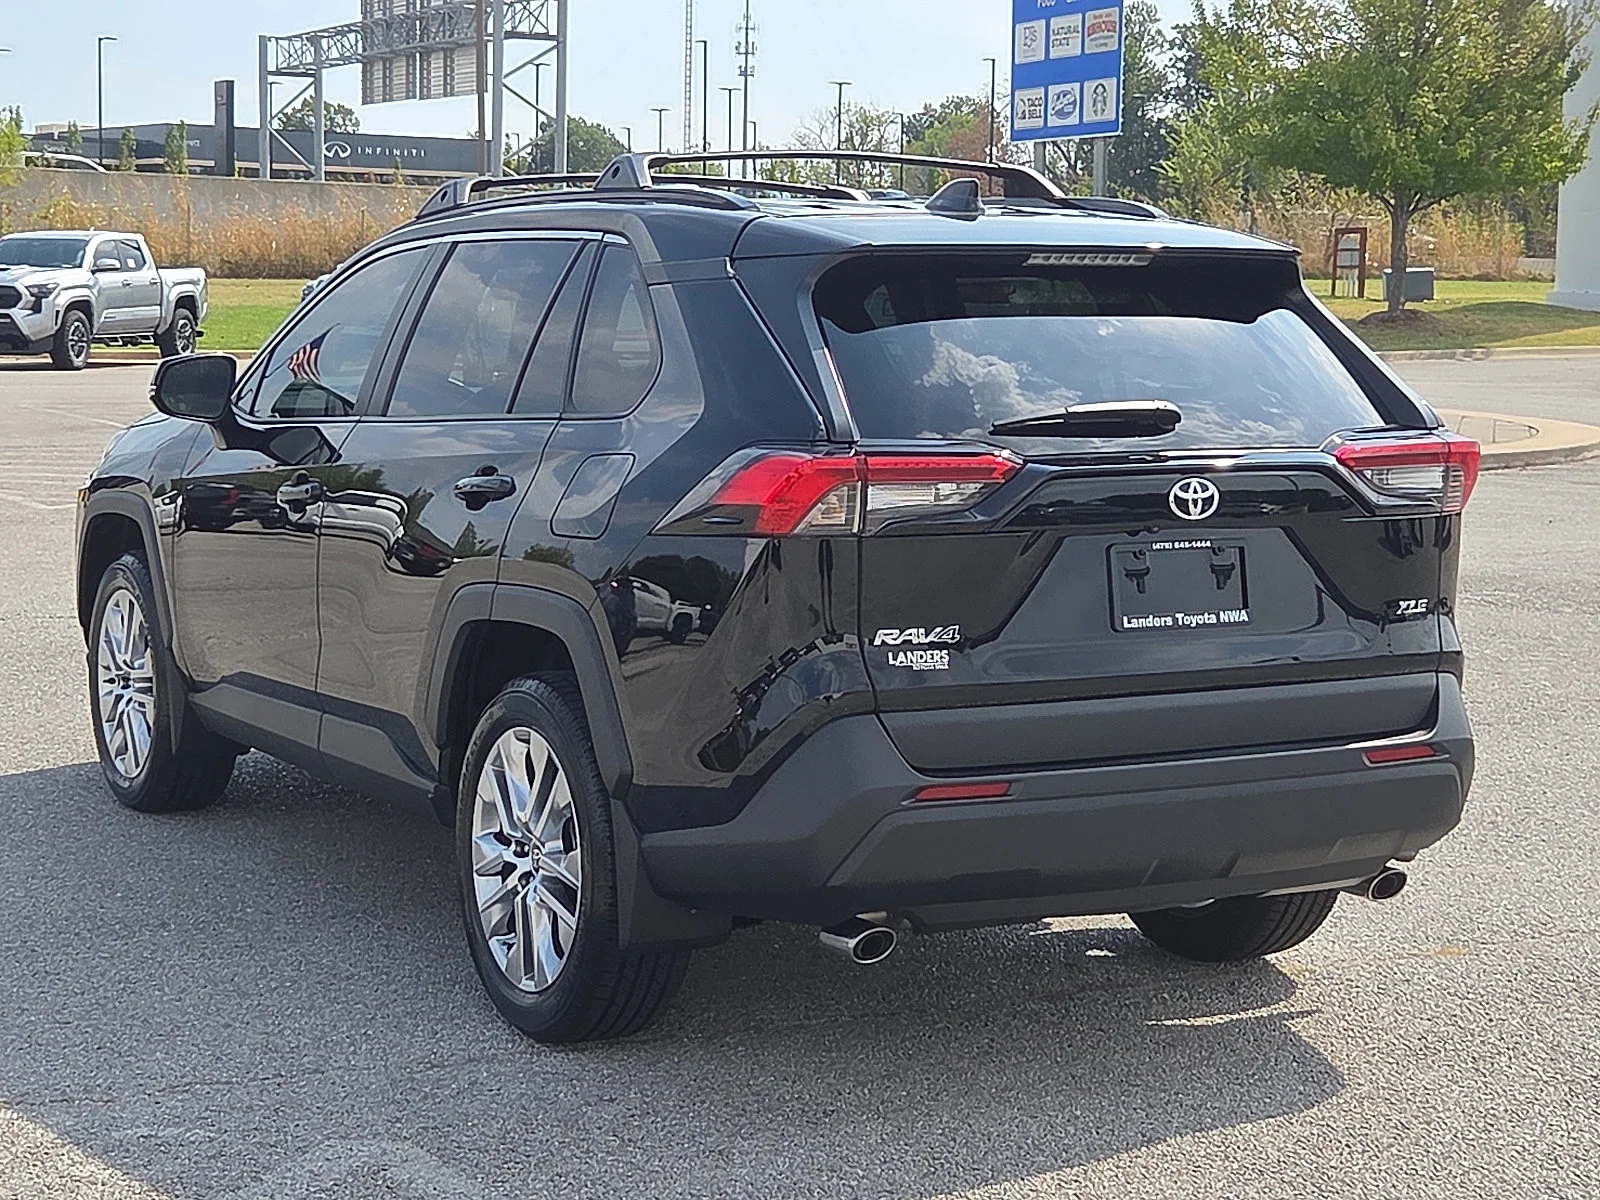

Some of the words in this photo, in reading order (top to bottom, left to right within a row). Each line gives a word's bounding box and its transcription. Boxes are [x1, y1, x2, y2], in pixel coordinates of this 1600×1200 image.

[1052, 24, 1080, 37] NATURAL
[1051, 37, 1070, 49] STATE
[1027, 97, 1043, 108] TACO
[1028, 108, 1042, 119] BELL
[357, 146, 426, 157] INFINITI
[1395, 599, 1429, 615] XLE
[1123, 615, 1173, 628] Landers
[1175, 612, 1217, 627] Toyota
[1219, 610, 1249, 623] NWA
[873, 625, 960, 645] RAV4
[888, 650, 949, 666] LANDERS
